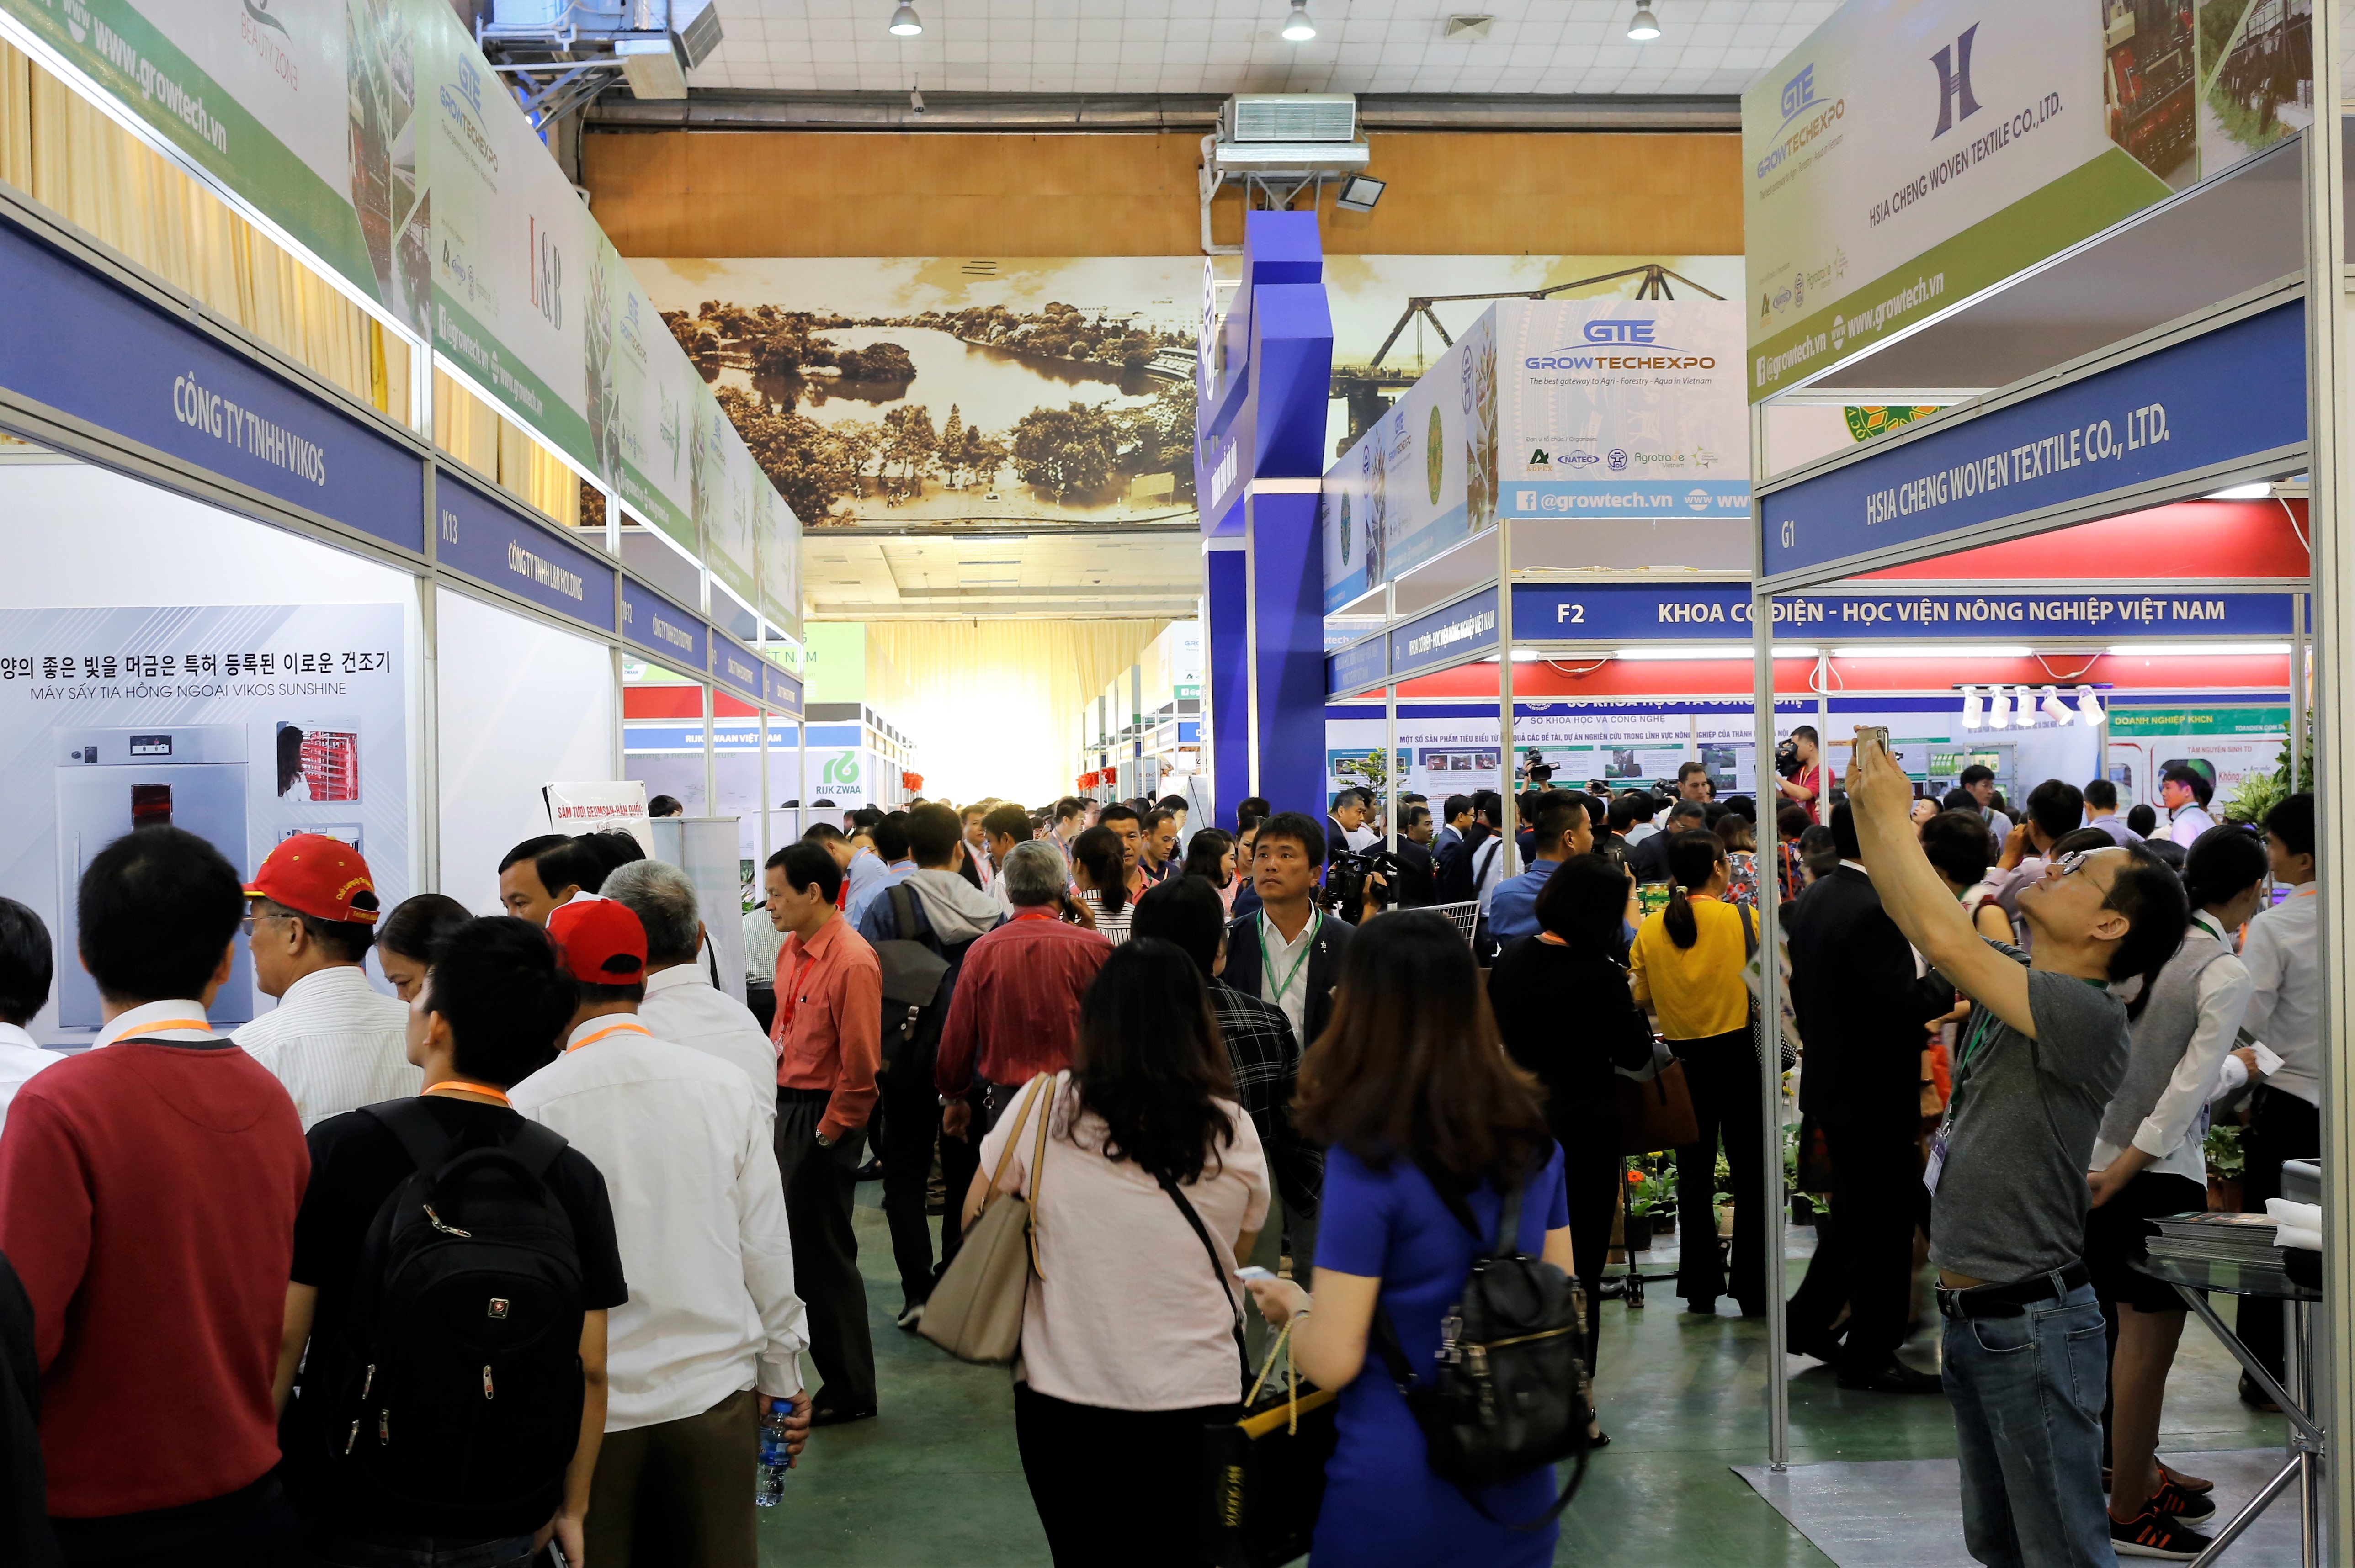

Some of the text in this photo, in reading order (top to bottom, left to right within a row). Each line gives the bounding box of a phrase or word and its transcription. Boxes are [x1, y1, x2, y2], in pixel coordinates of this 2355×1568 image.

[241, 12, 273, 66] BEAUTY
[94, 16, 227, 154] www.growtech.vn
[1781, 61, 1814, 119] GTE
[440, 85, 498, 173] GROWTECHEXPO
[1757, 98, 1845, 179] GROWTECHEXPO
[1869, 199, 1890, 228] HSIA
[1893, 175, 1928, 213] CHENG
[1929, 148, 1969, 191] WOVEN
[1971, 121, 2009, 165] TEXTILE
[529, 214, 562, 331] L&B
[1583, 319, 1656, 343] GTE
[1767, 333, 1826, 381] @growtech.vn
[1848, 273, 1944, 339] www.growtech.vn
[1525, 357, 1716, 369] GROWTECHEXPO
[1560, 378, 1590, 387] gateway
[1600, 377, 1615, 387] Agri
[1621, 377, 1648, 387] Forestry
[1654, 377, 1673, 387] Aqua
[174, 371, 326, 487] CÔNG TY TNHH VIKOS
[1635, 450, 1685, 464] Agrotrade
[1867, 403, 2170, 525] HSIA CHENG WOVEN TEXTILE CO., LTD.
[1542, 492, 1673, 512] @growtech.vn
[442, 509, 457, 545] K13
[1782, 520, 1795, 549] G1
[508, 539, 583, 601] CÔNG TY TNHH L&B HOLDING
[1558, 597, 2226, 627] F2 KHOA ĐIỆN HỌC VIỆN NÔNG NGHIỆP VIỆT NAM
[43, 657, 76, 679] 좋은
[85, 655, 117, 678] 빛을
[126, 655, 176, 678] 머금은
[184, 653, 217, 677] 특허
[225, 652, 275, 676] 등록된
[284, 652, 334, 675] 이로운
[342, 650, 391, 674] 건조기
[786, 651, 817, 662] NM
[31, 681, 347, 700] MÁY SẤY TIA HỒNG NGOẠI VIKOS SUNSHINE
[1574, 716, 1593, 725] HỌC
[2115, 716, 2148, 725] DOANH
[686, 732, 782, 744] RIJK WAAN VIỆT AM
[1399, 735, 1413, 744] MỘT
[1415, 734, 1424, 743] SỐ
[1425, 734, 1438, 743] SẢN
[1440, 733, 1458, 743] PHẨM
[1460, 733, 1473, 742] TIÊU
[1475, 732, 1489, 742] BIỂU
[1491, 733, 1499, 742] TỪ
[1527, 733, 1539, 741] CÁC
[1574, 732, 1583, 740] ÁN
[1584, 731, 1607, 740] NGHIÊN
[1609, 731, 1622, 740] CỨU
[1696, 730, 1716, 740] GHIỆP
[1732, 729, 1752, 737] THÀNH
[816, 785, 861, 794] RIJK ZWAA
[558, 804, 571, 819] SÂM
[572, 805, 586, 818] TƯƠI
